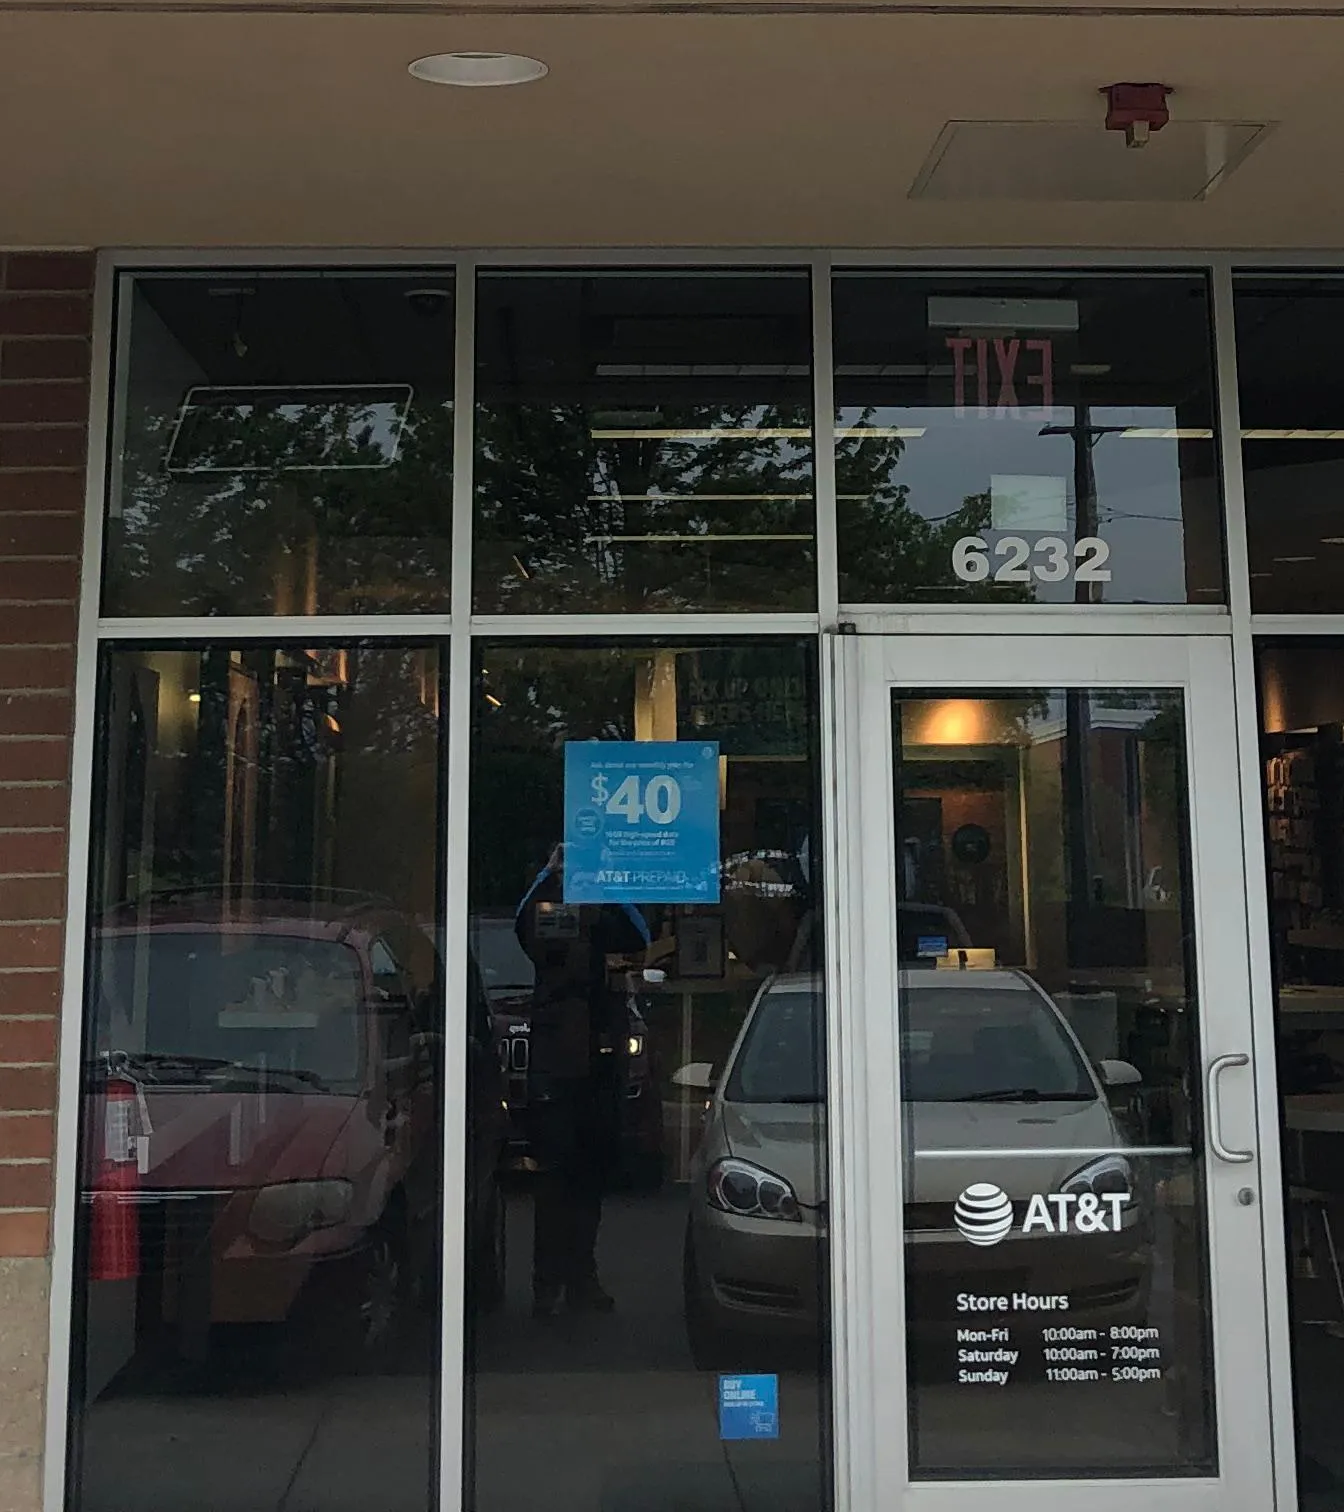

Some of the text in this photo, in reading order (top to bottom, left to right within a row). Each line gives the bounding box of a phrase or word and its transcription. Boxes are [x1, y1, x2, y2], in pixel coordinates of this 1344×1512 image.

[951, 536, 1112, 582] 6232
[591, 772, 682, 824] $40
[597, 870, 687, 883] AT&T PREPAID
[1022, 1192, 1131, 1233] AT&T
[956, 1293, 1069, 1311] Store Hours
[957, 1328, 1009, 1342] Mon-Fri
[1041, 1328, 1097, 1342] 10:00am
[1109, 1326, 1159, 1342] 8:00pm
[958, 1349, 1019, 1365] Saturday
[1043, 1348, 1098, 1361] 10:00am
[1111, 1346, 1160, 1361] 7:00pm
[958, 1369, 1009, 1386] Sunday
[1045, 1368, 1099, 1381] 11:00am
[1111, 1367, 1161, 1382] 5:00pm
